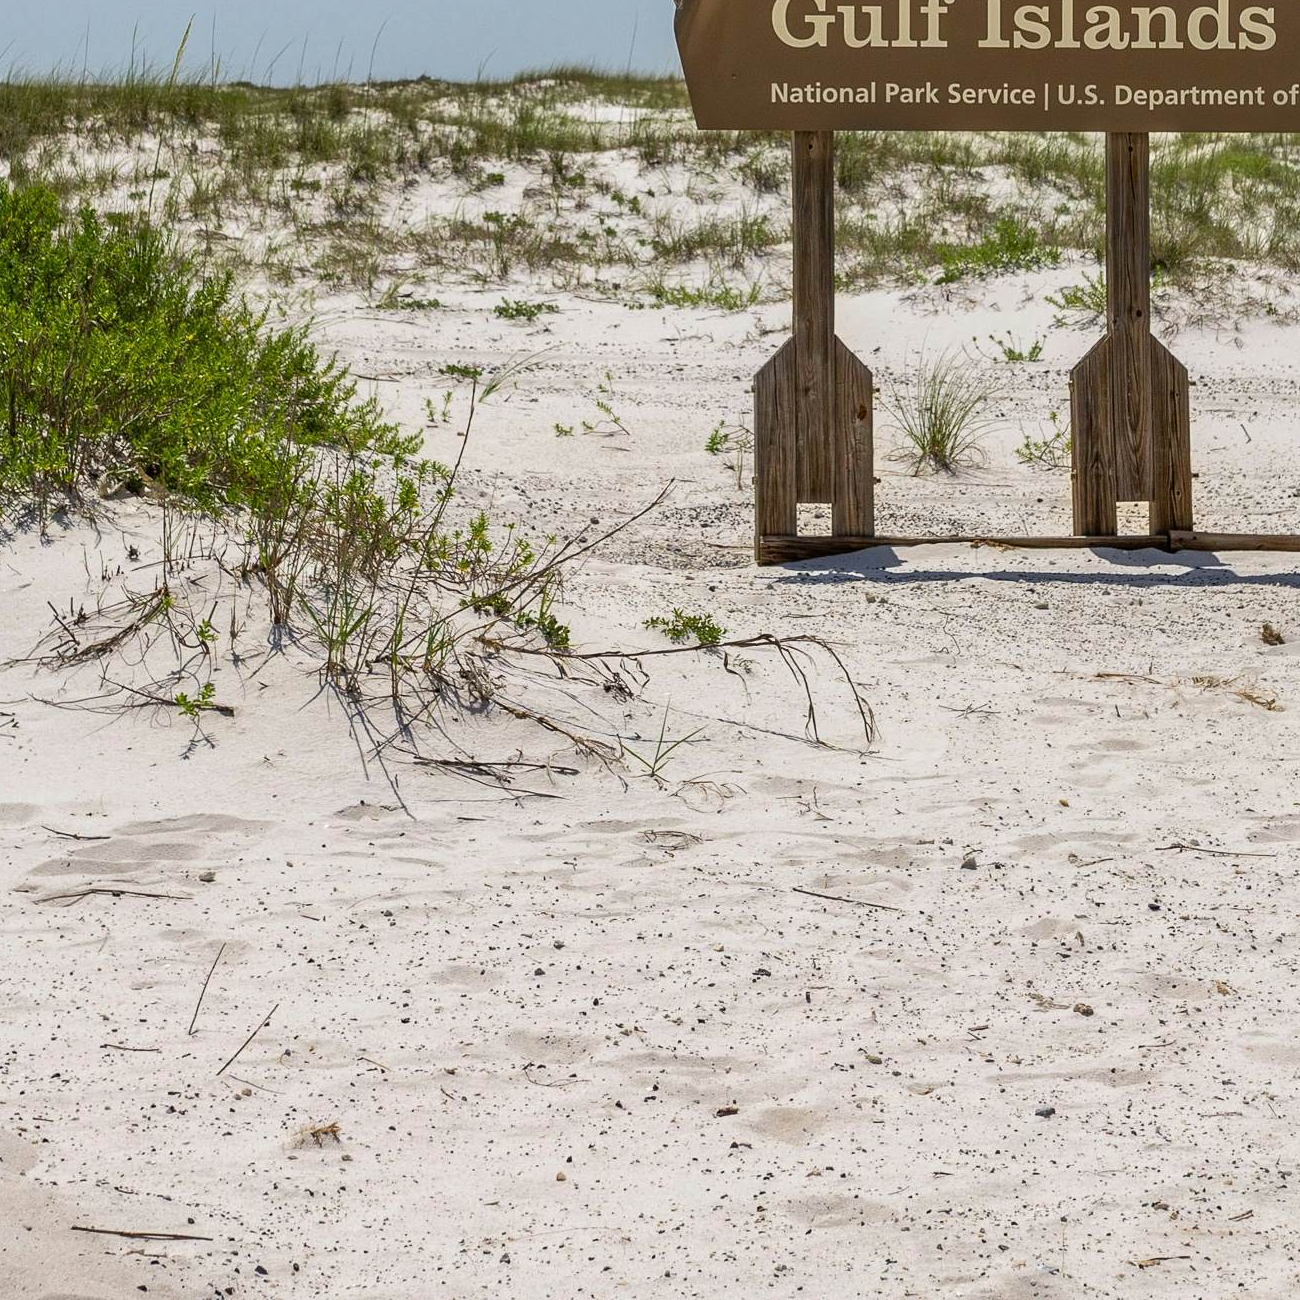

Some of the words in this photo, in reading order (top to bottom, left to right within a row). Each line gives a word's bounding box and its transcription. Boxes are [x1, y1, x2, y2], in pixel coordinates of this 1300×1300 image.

[771, 82, 877, 104] National
[885, 82, 940, 104] Park
[948, 83, 1036, 105] Service
[1058, 84, 1105, 106] U.S.
[1115, 84, 1265, 111] Department
[1273, 83, 1300, 106] of
